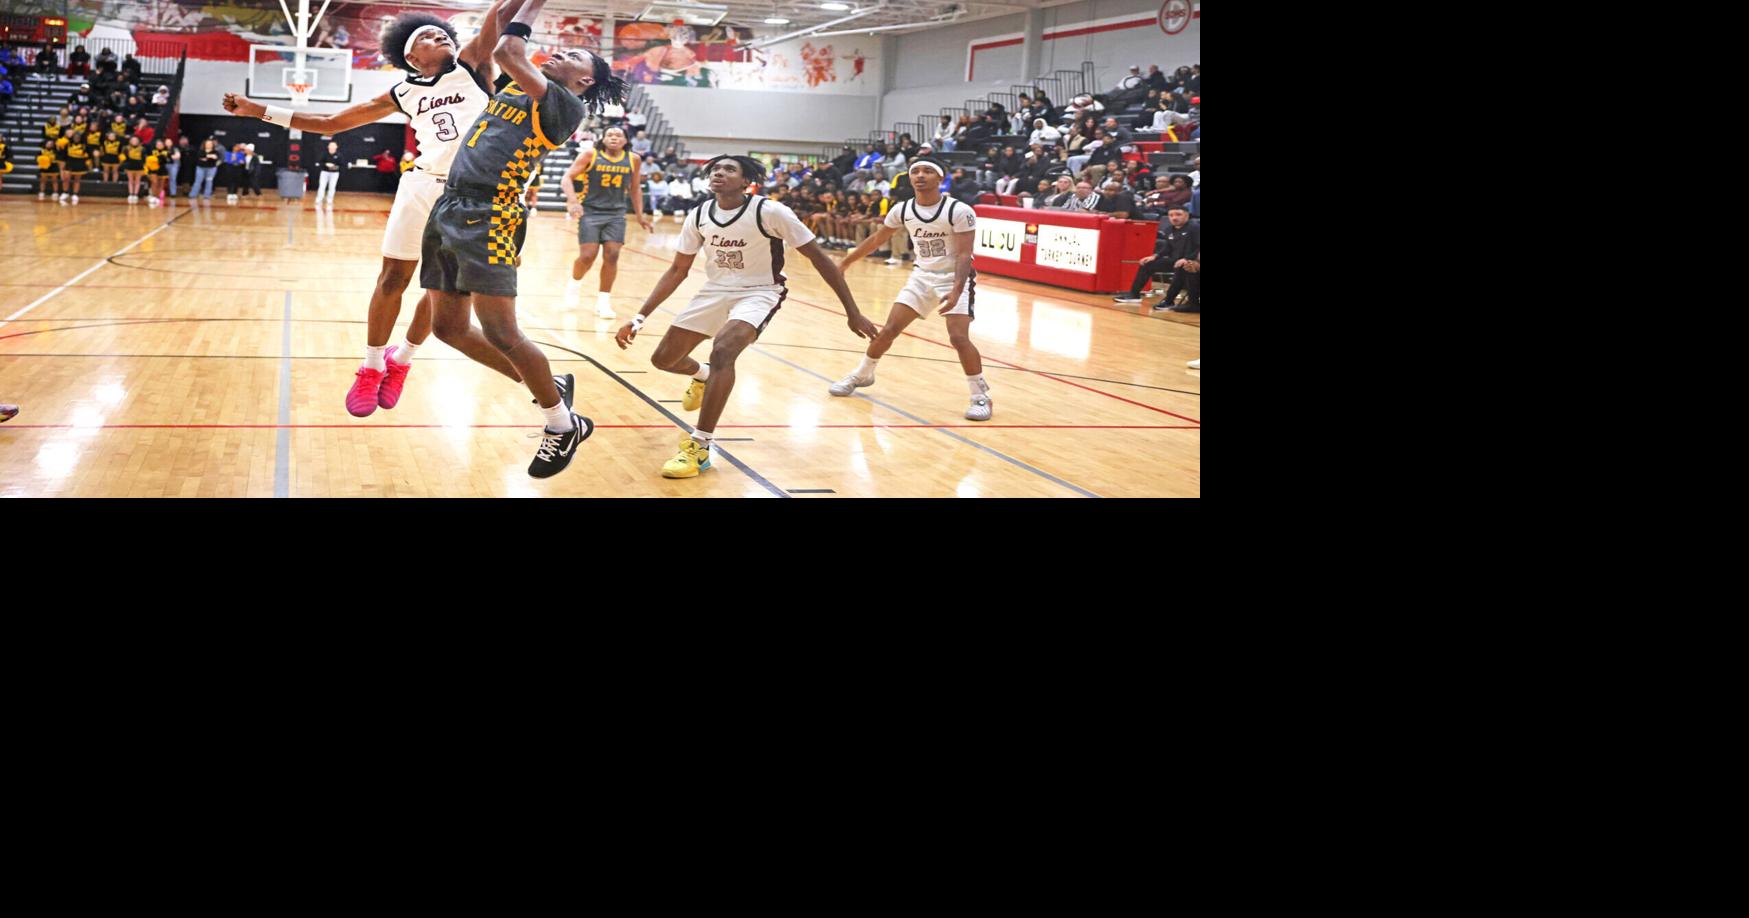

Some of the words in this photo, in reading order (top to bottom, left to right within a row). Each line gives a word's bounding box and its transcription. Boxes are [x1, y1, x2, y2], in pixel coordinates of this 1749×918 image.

[416, 93, 465, 115] Lions
[432, 111, 459, 142] 3
[466, 119, 489, 149] 1
[600, 173, 623, 188] 24
[710, 234, 748, 248] Lions
